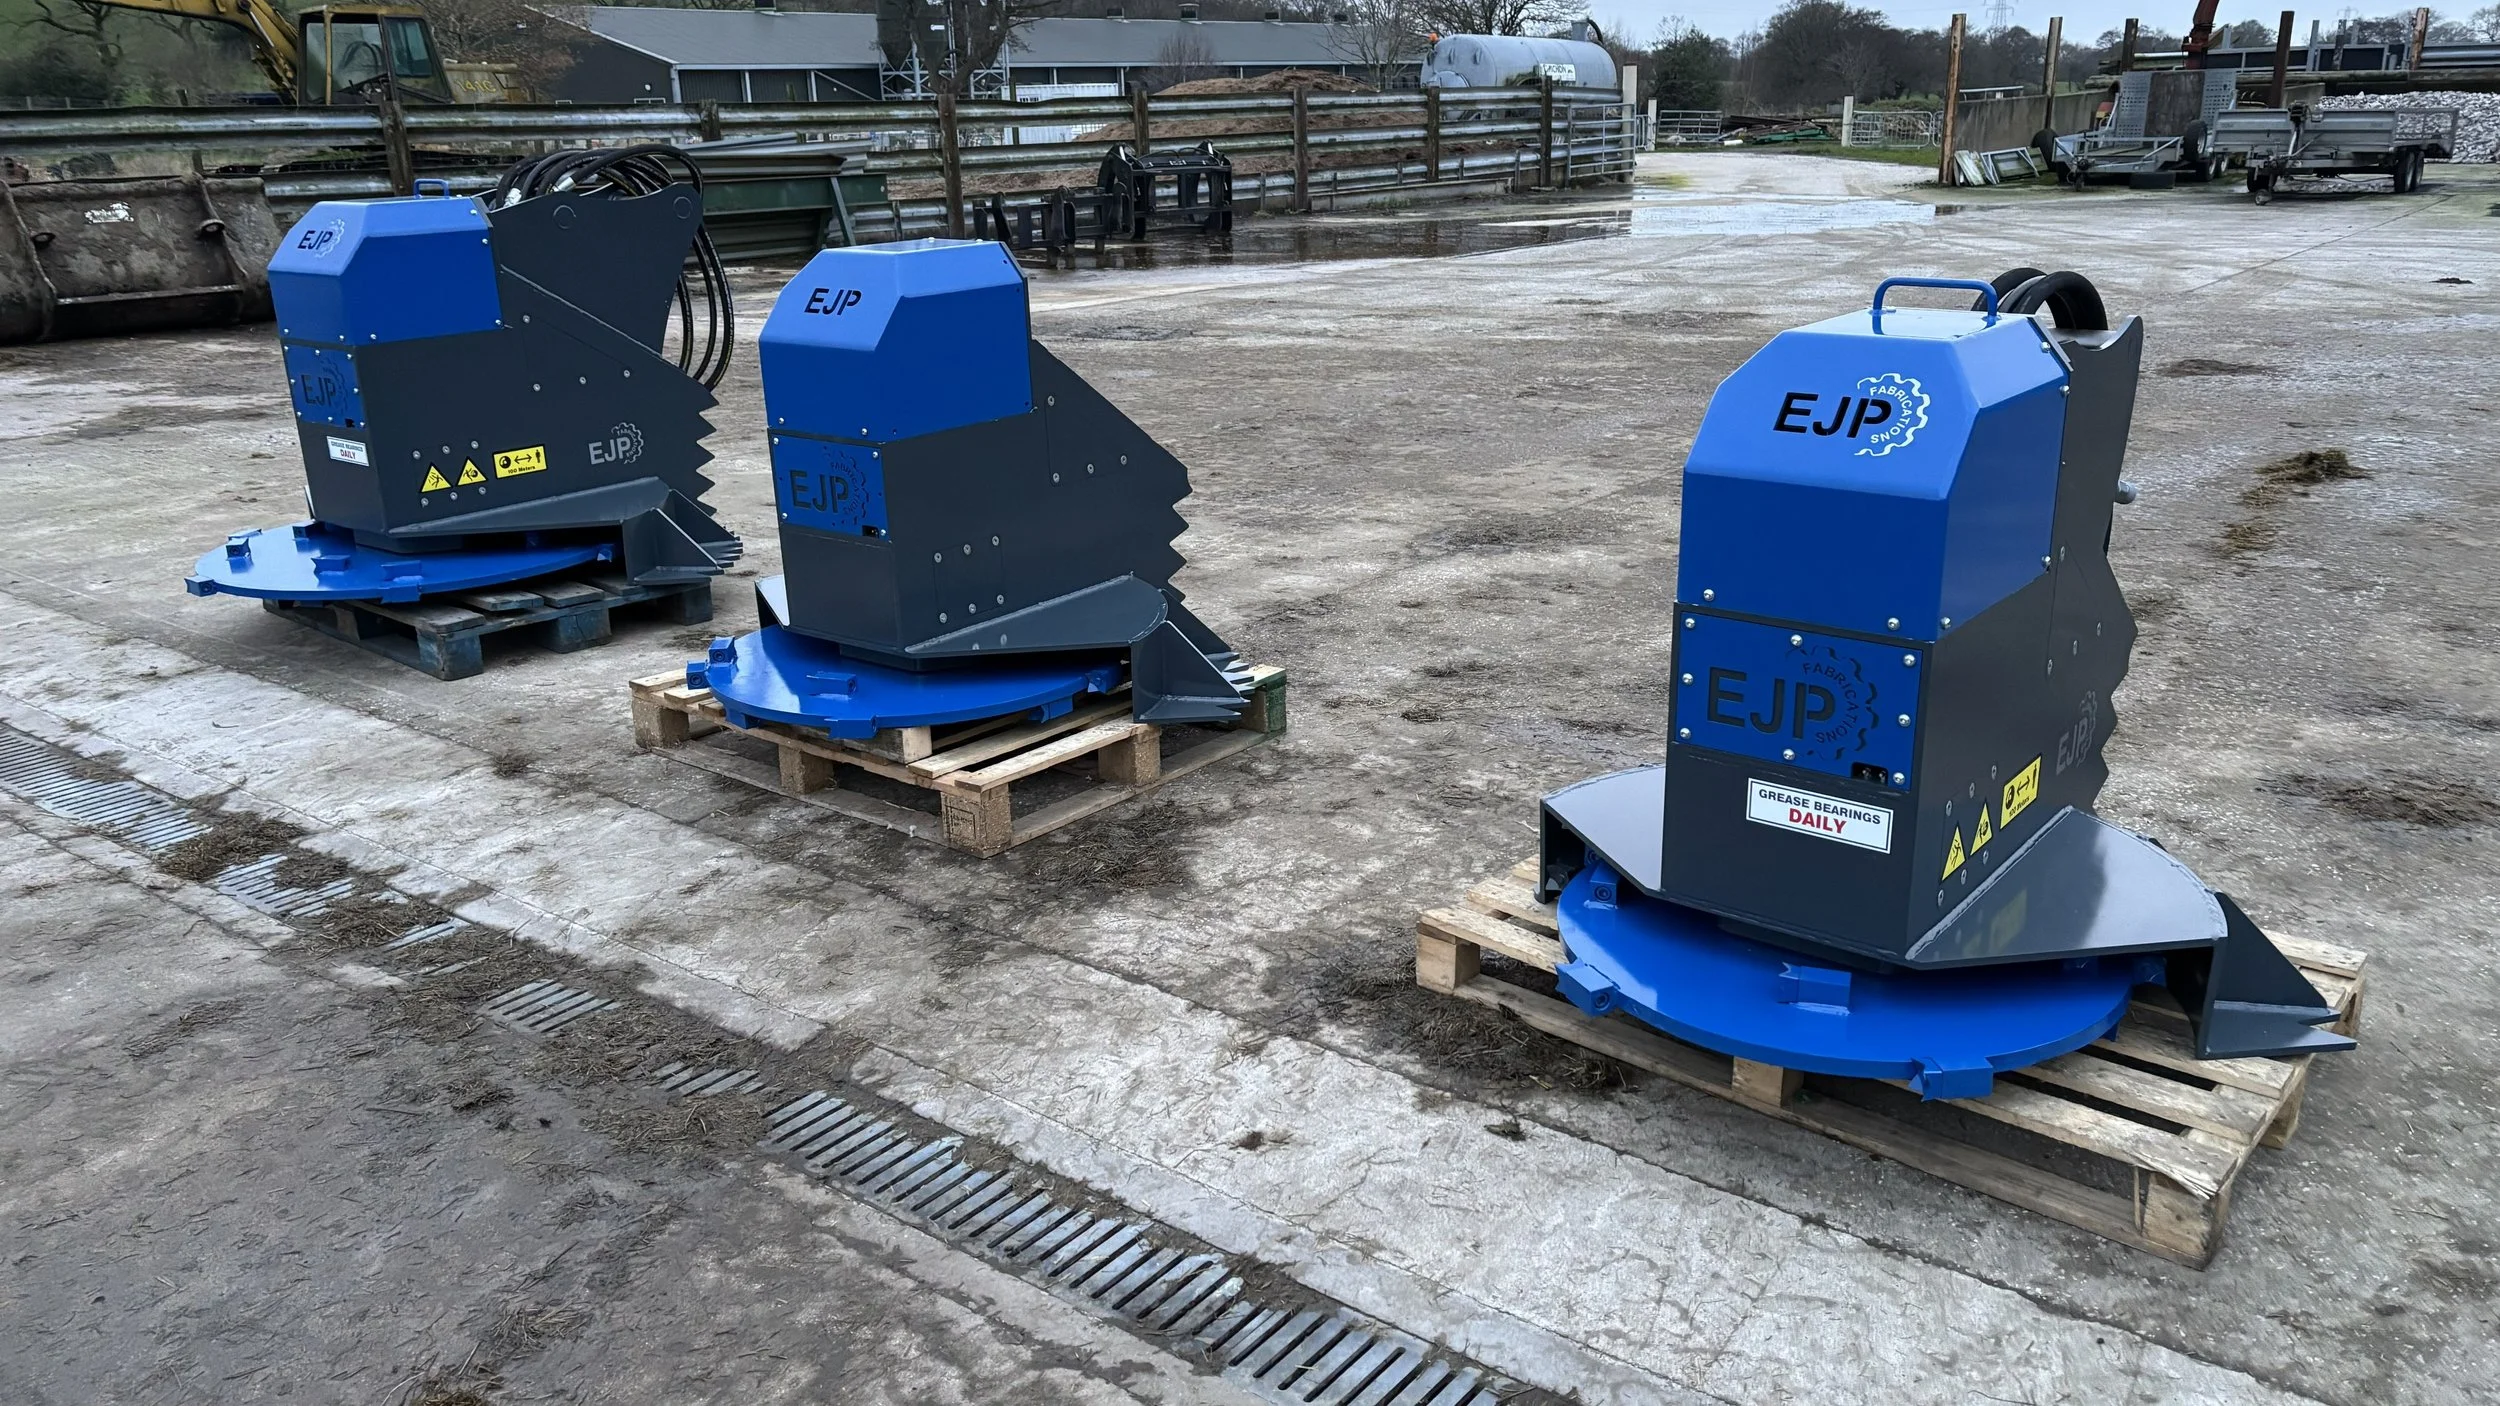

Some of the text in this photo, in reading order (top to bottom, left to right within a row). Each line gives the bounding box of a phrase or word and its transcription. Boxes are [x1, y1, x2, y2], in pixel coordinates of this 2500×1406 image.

[297, 230, 334, 250] EJP
[804, 288, 862, 315] EJP
[301, 374, 336, 407] EJP
[1773, 392, 1892, 439] EJP
[1870, 385, 1912, 444] FABRICATIONS
[589, 437, 631, 465] EJP
[790, 470, 848, 514] EJP
[1707, 666, 1836, 740] EJP
[1802, 662, 1860, 744] FABRICATIONS
[2056, 717, 2088, 776] EJP
[1759, 788, 1881, 825] GREASE BEARINGS
[1789, 807, 1846, 834] DAILY
